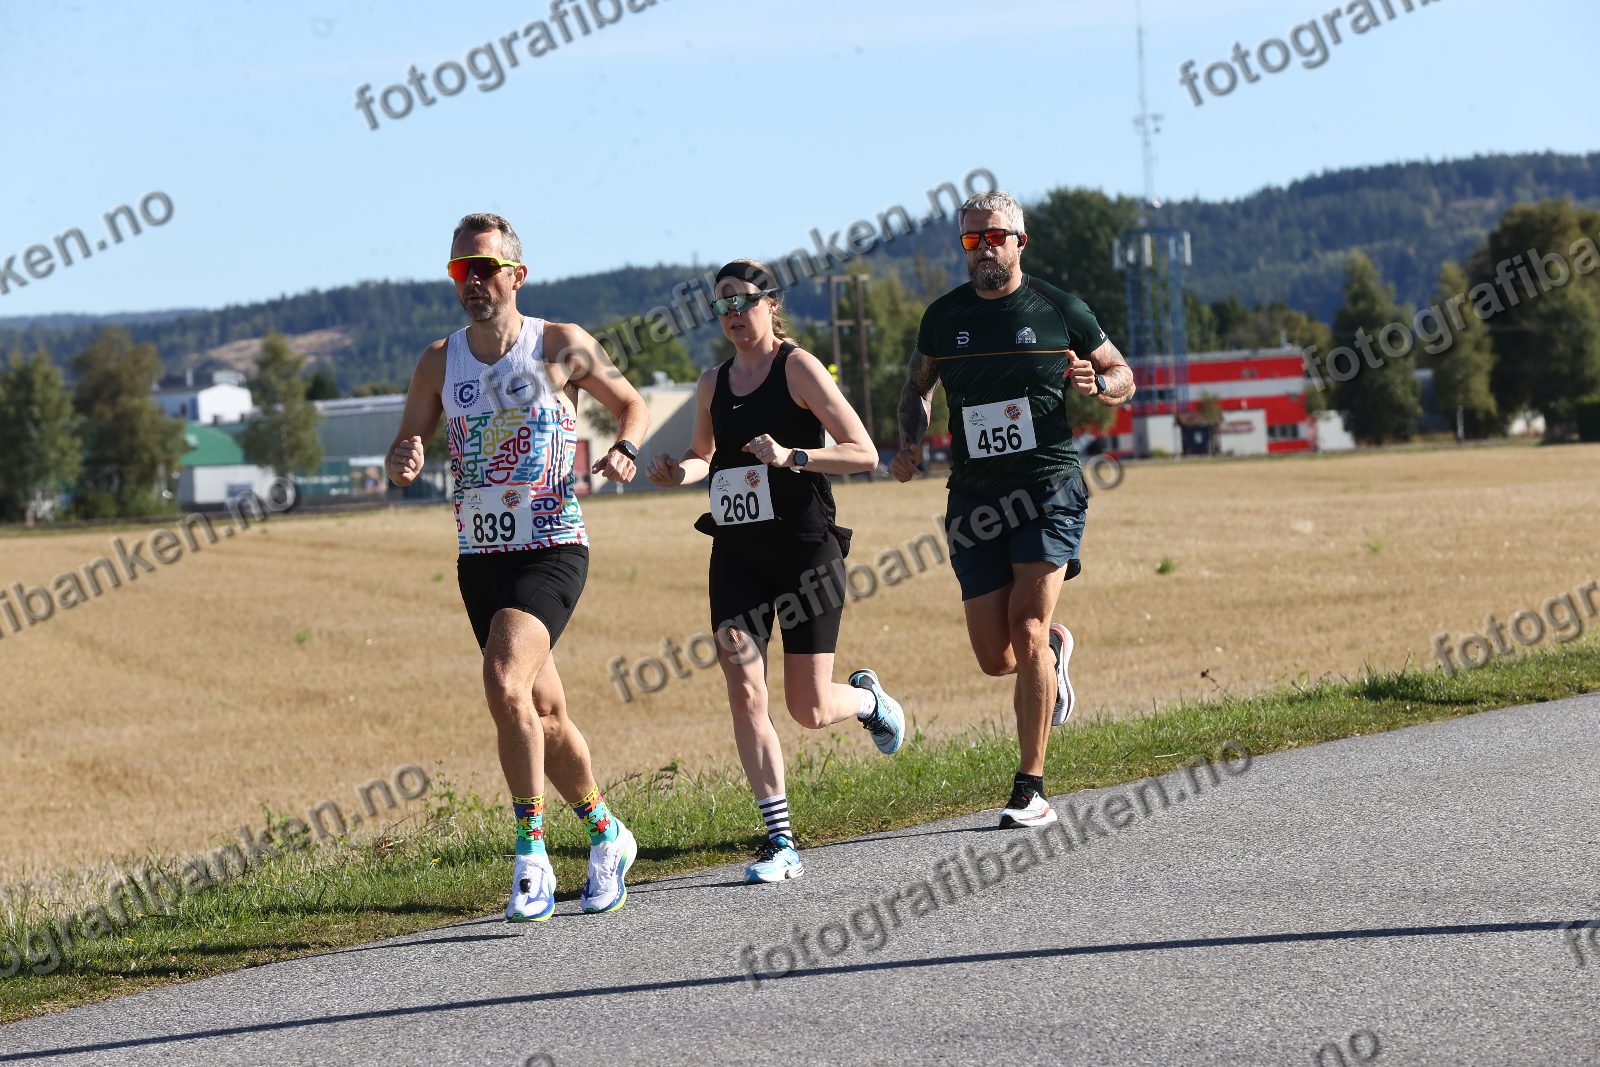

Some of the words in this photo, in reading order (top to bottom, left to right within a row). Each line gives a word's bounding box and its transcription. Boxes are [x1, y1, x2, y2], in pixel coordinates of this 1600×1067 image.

[978, 424, 1022, 454] 456
[721, 492, 760, 522] 260
[473, 511, 516, 543] 839
